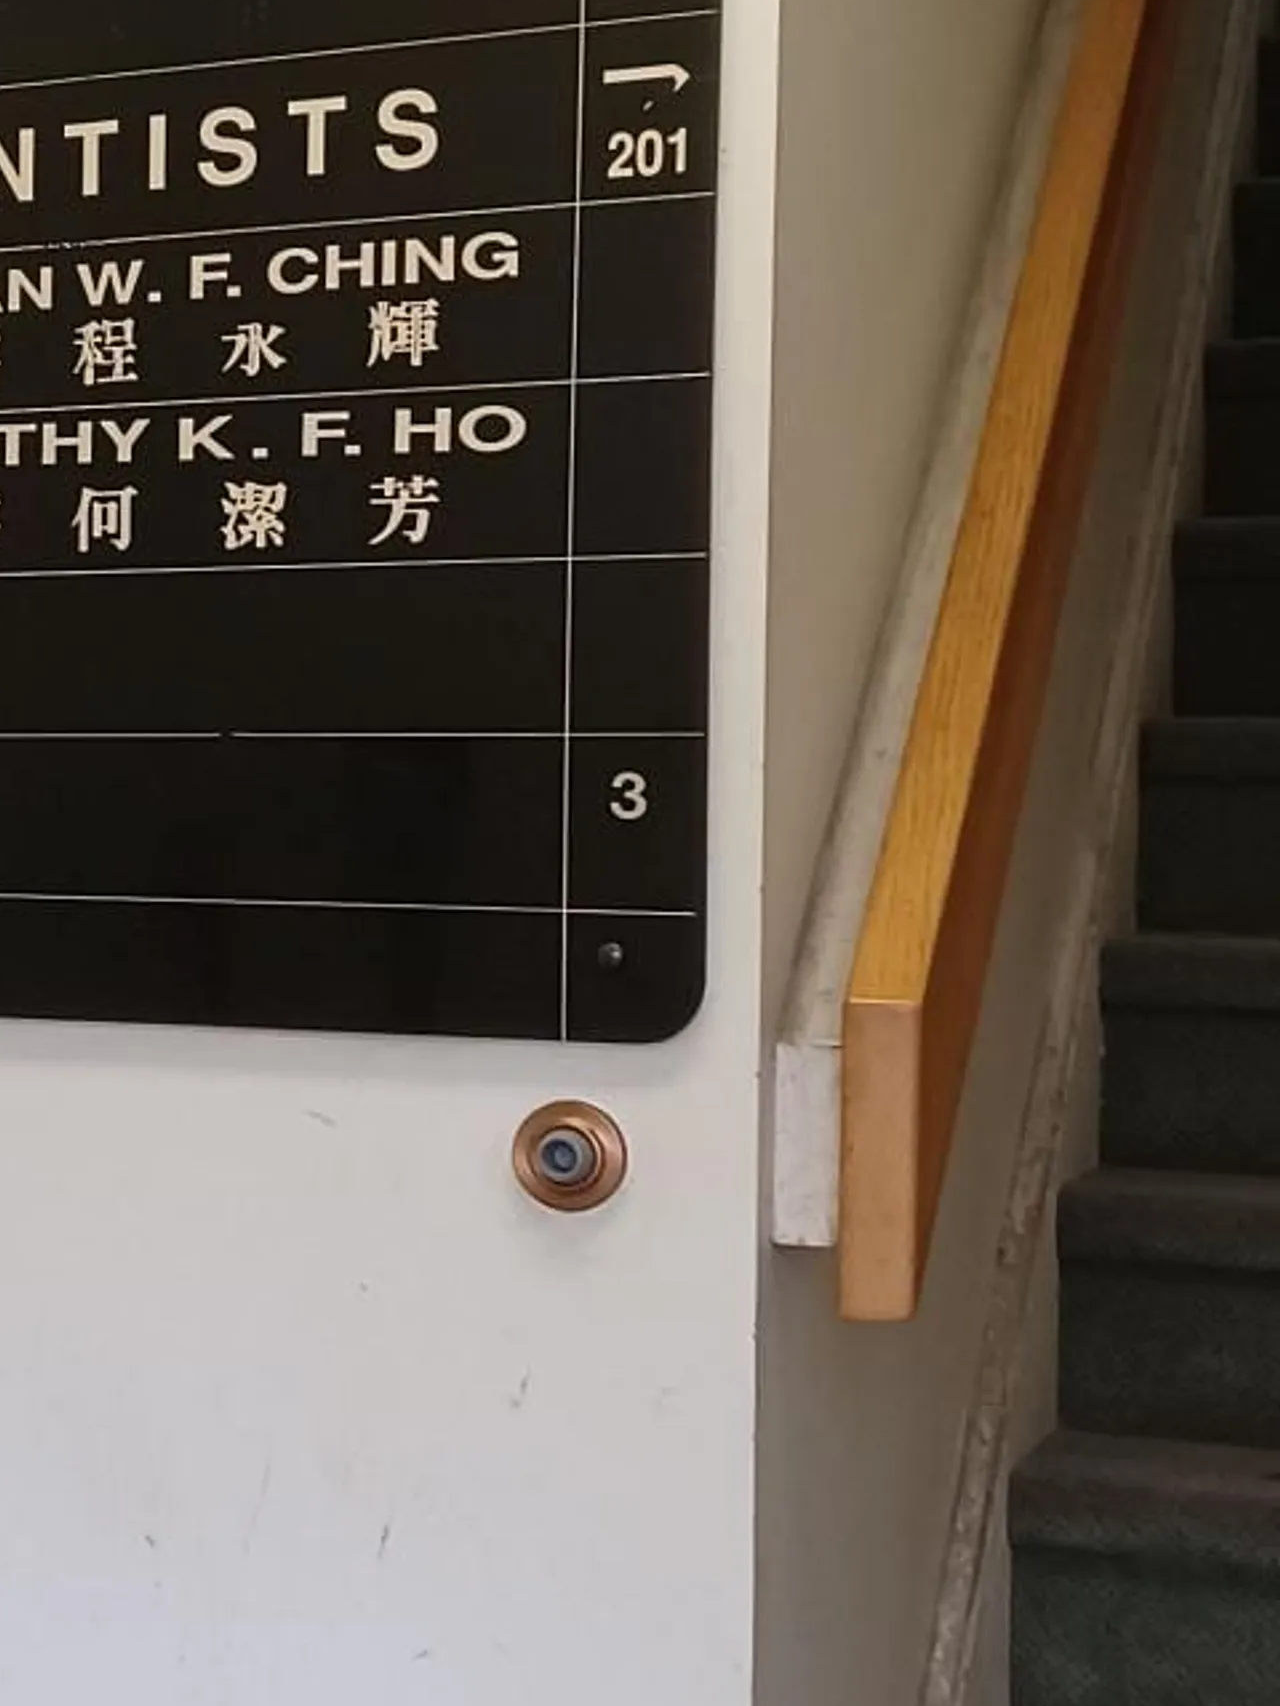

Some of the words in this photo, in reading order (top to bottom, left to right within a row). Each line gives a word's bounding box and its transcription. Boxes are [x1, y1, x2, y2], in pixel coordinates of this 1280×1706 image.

[607, 127, 687, 179] 201
[76, 259, 162, 306] W.
[189, 252, 241, 300] F.
[267, 231, 519, 294] CHING
[301, 410, 361, 457] F.
[394, 405, 527, 454] HO
[610, 772, 647, 819] 3
